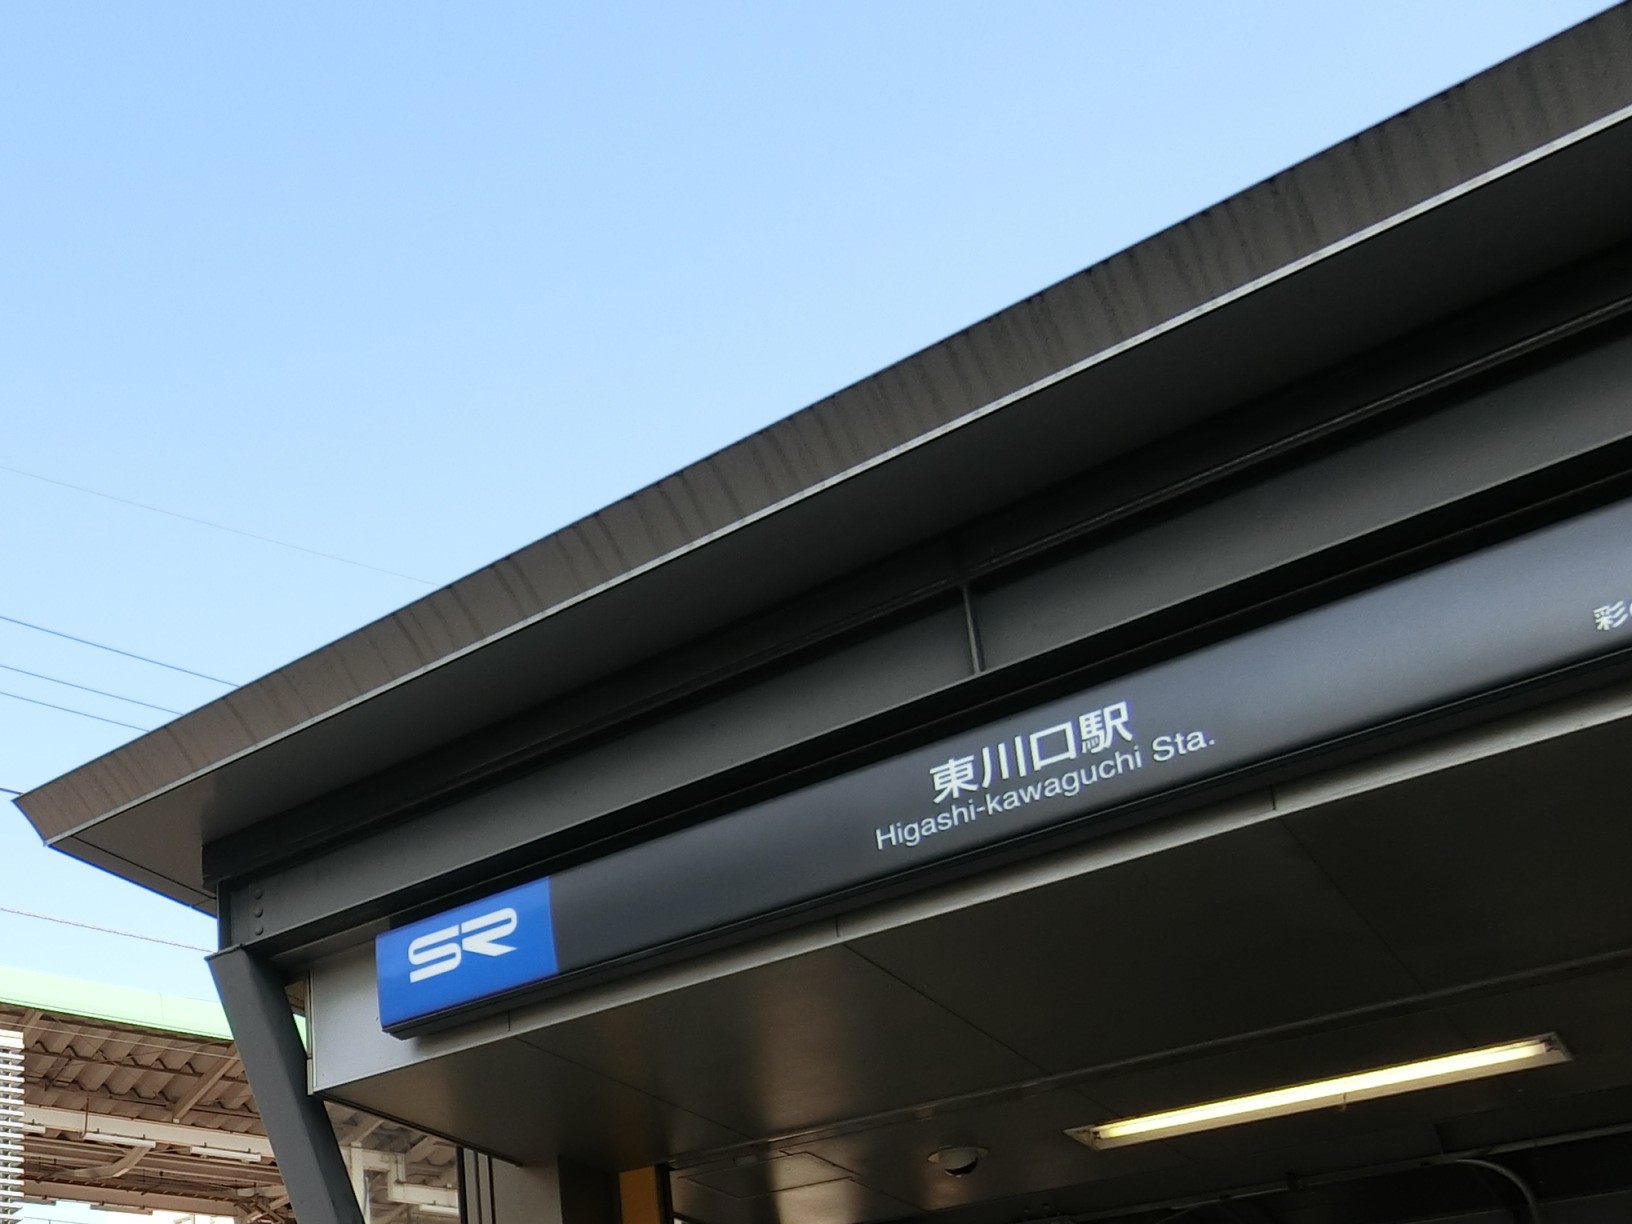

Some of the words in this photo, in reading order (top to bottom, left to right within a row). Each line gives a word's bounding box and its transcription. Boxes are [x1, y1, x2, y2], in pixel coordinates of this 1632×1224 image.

[1593, 600, 1632, 631] 彩
[875, 744, 1144, 849] Higashi-kawaguchi
[1152, 729, 1216, 765] Sta.
[929, 701, 1134, 804] 東川口駅
[408, 907, 518, 983] SR
